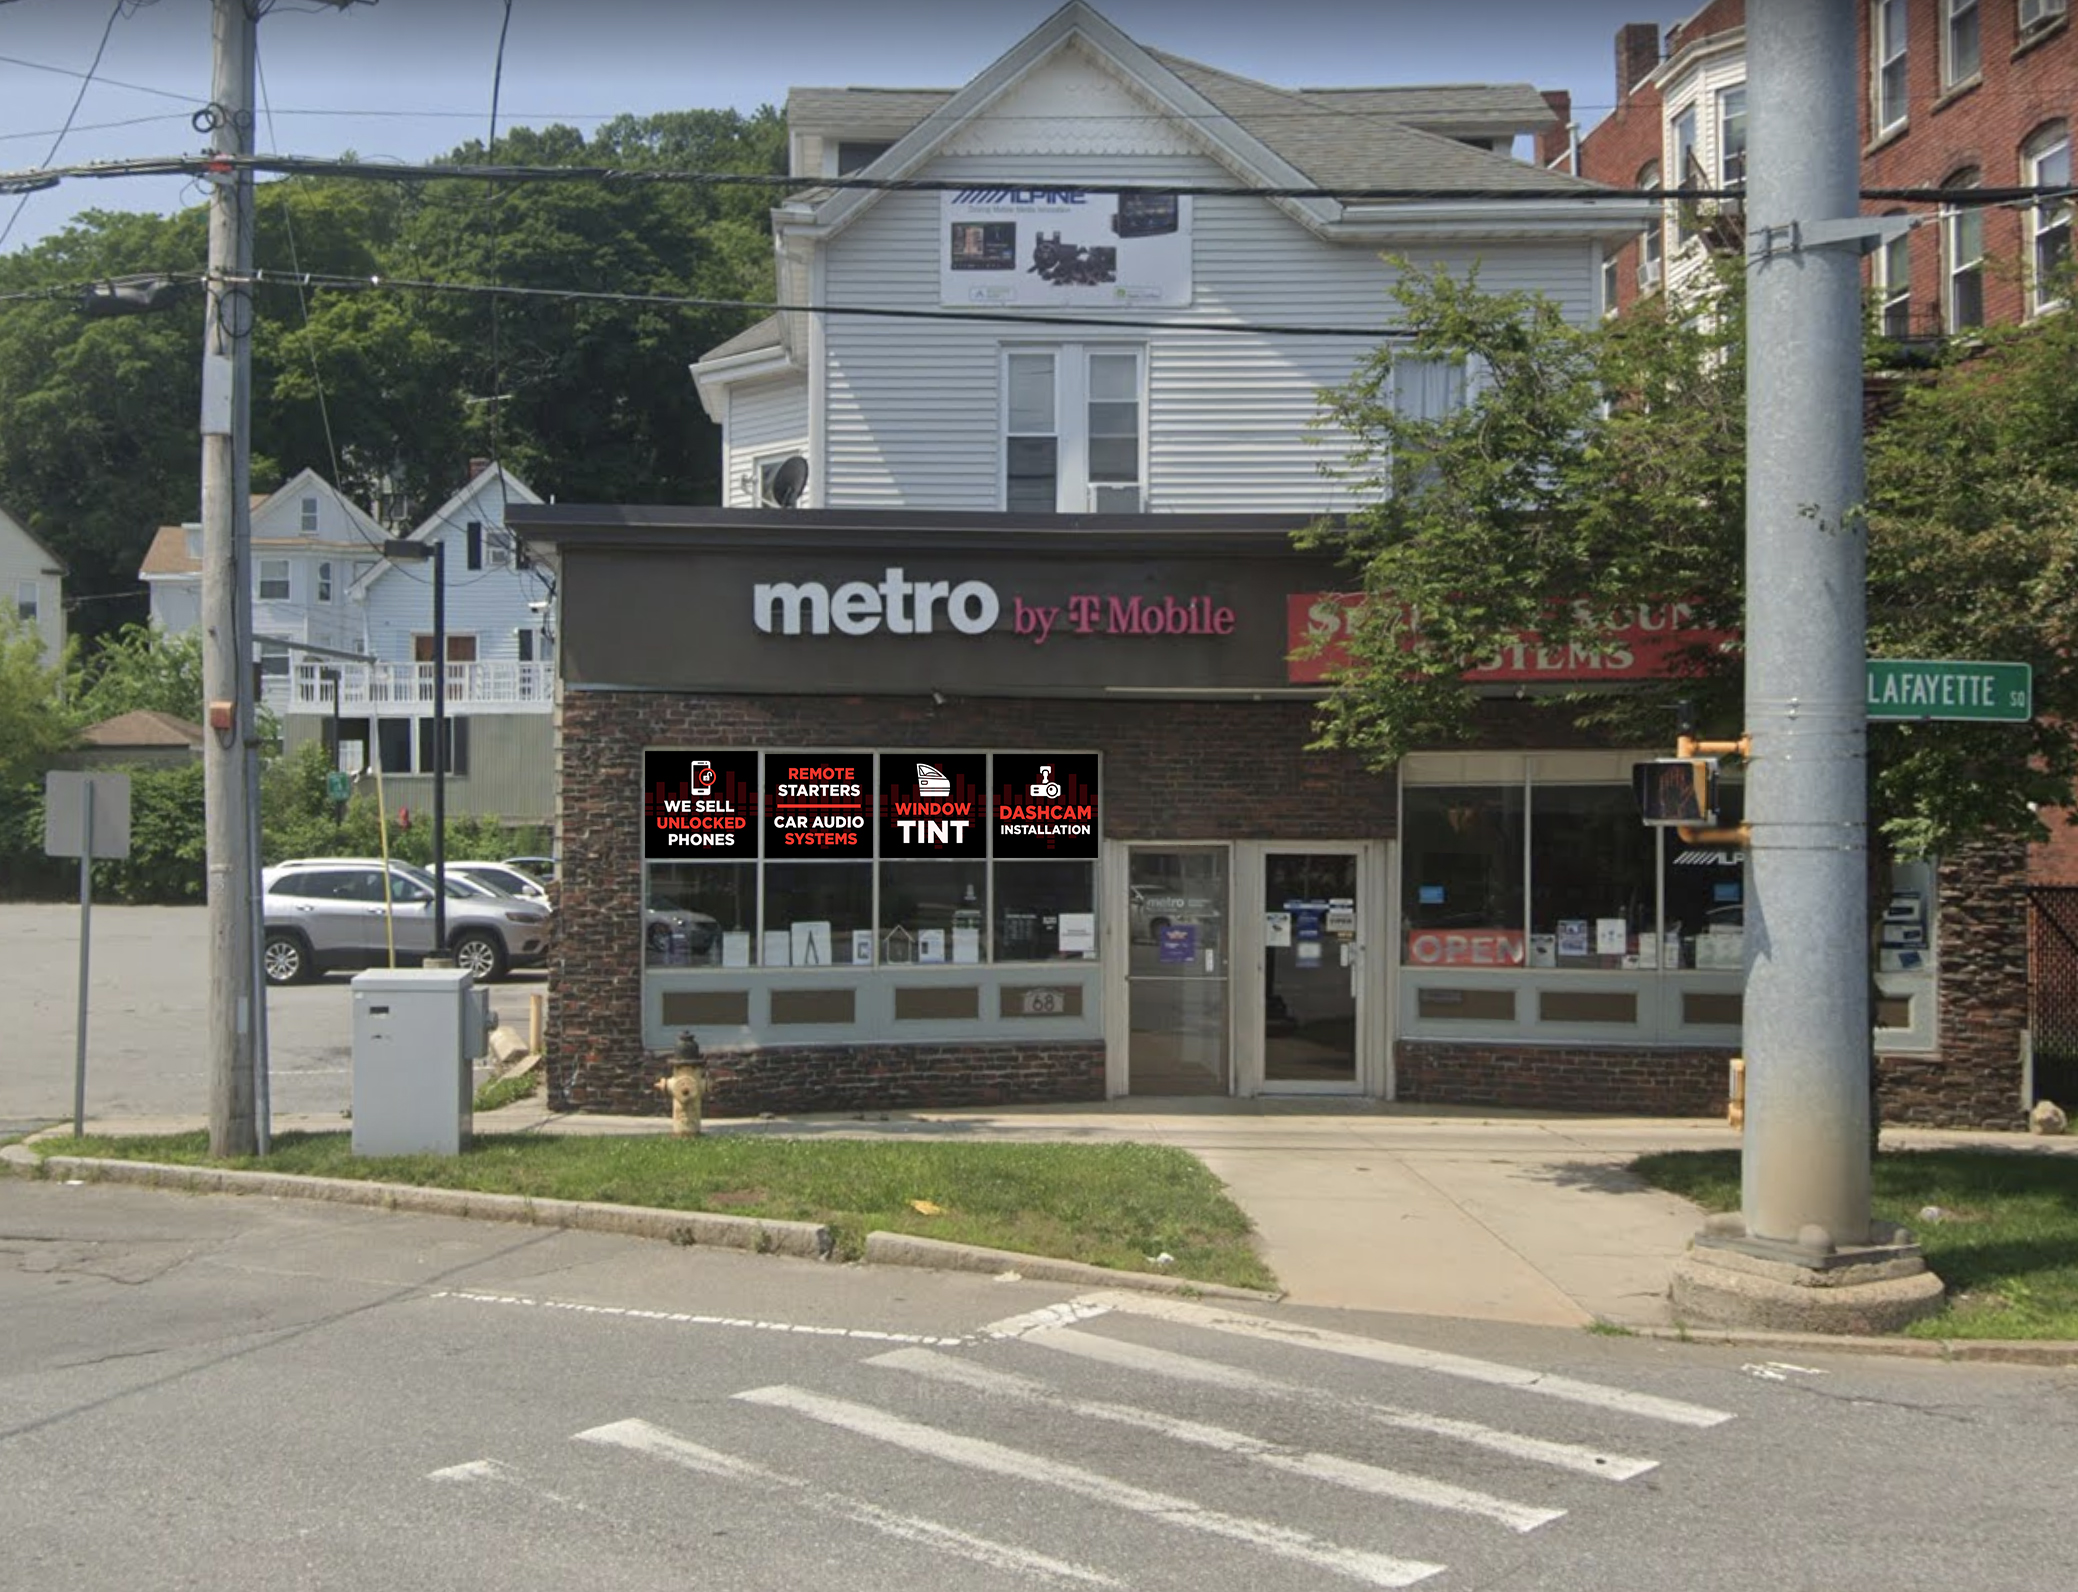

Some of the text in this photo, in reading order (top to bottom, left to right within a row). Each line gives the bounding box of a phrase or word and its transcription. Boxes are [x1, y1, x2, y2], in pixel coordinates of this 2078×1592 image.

[987, 189, 1087, 204] ALPINE
[754, 567, 1000, 635] metro
[1013, 596, 1060, 643] by
[1107, 596, 1235, 634] Mobile
[1568, 598, 1722, 632] SOUN
[1868, 673, 2025, 708] LAFAYETTE SQ
[788, 767, 855, 780] REMOTE
[778, 784, 861, 797] STARTERS
[664, 800, 735, 813] WE SELL
[895, 802, 972, 816] WINDOW
[1000, 805, 1092, 820] DASHCAM
[656, 816, 747, 830] UNLOCKED
[774, 816, 865, 829] CAR AUDIO
[897, 820, 970, 844] TINT
[1000, 824, 1091, 836] INSTALLATION
[668, 833, 735, 846] PHONES
[784, 832, 858, 845] SYSTEMS
[1412, 934, 1525, 964] OPEN
[1032, 994, 1056, 1012] 68
